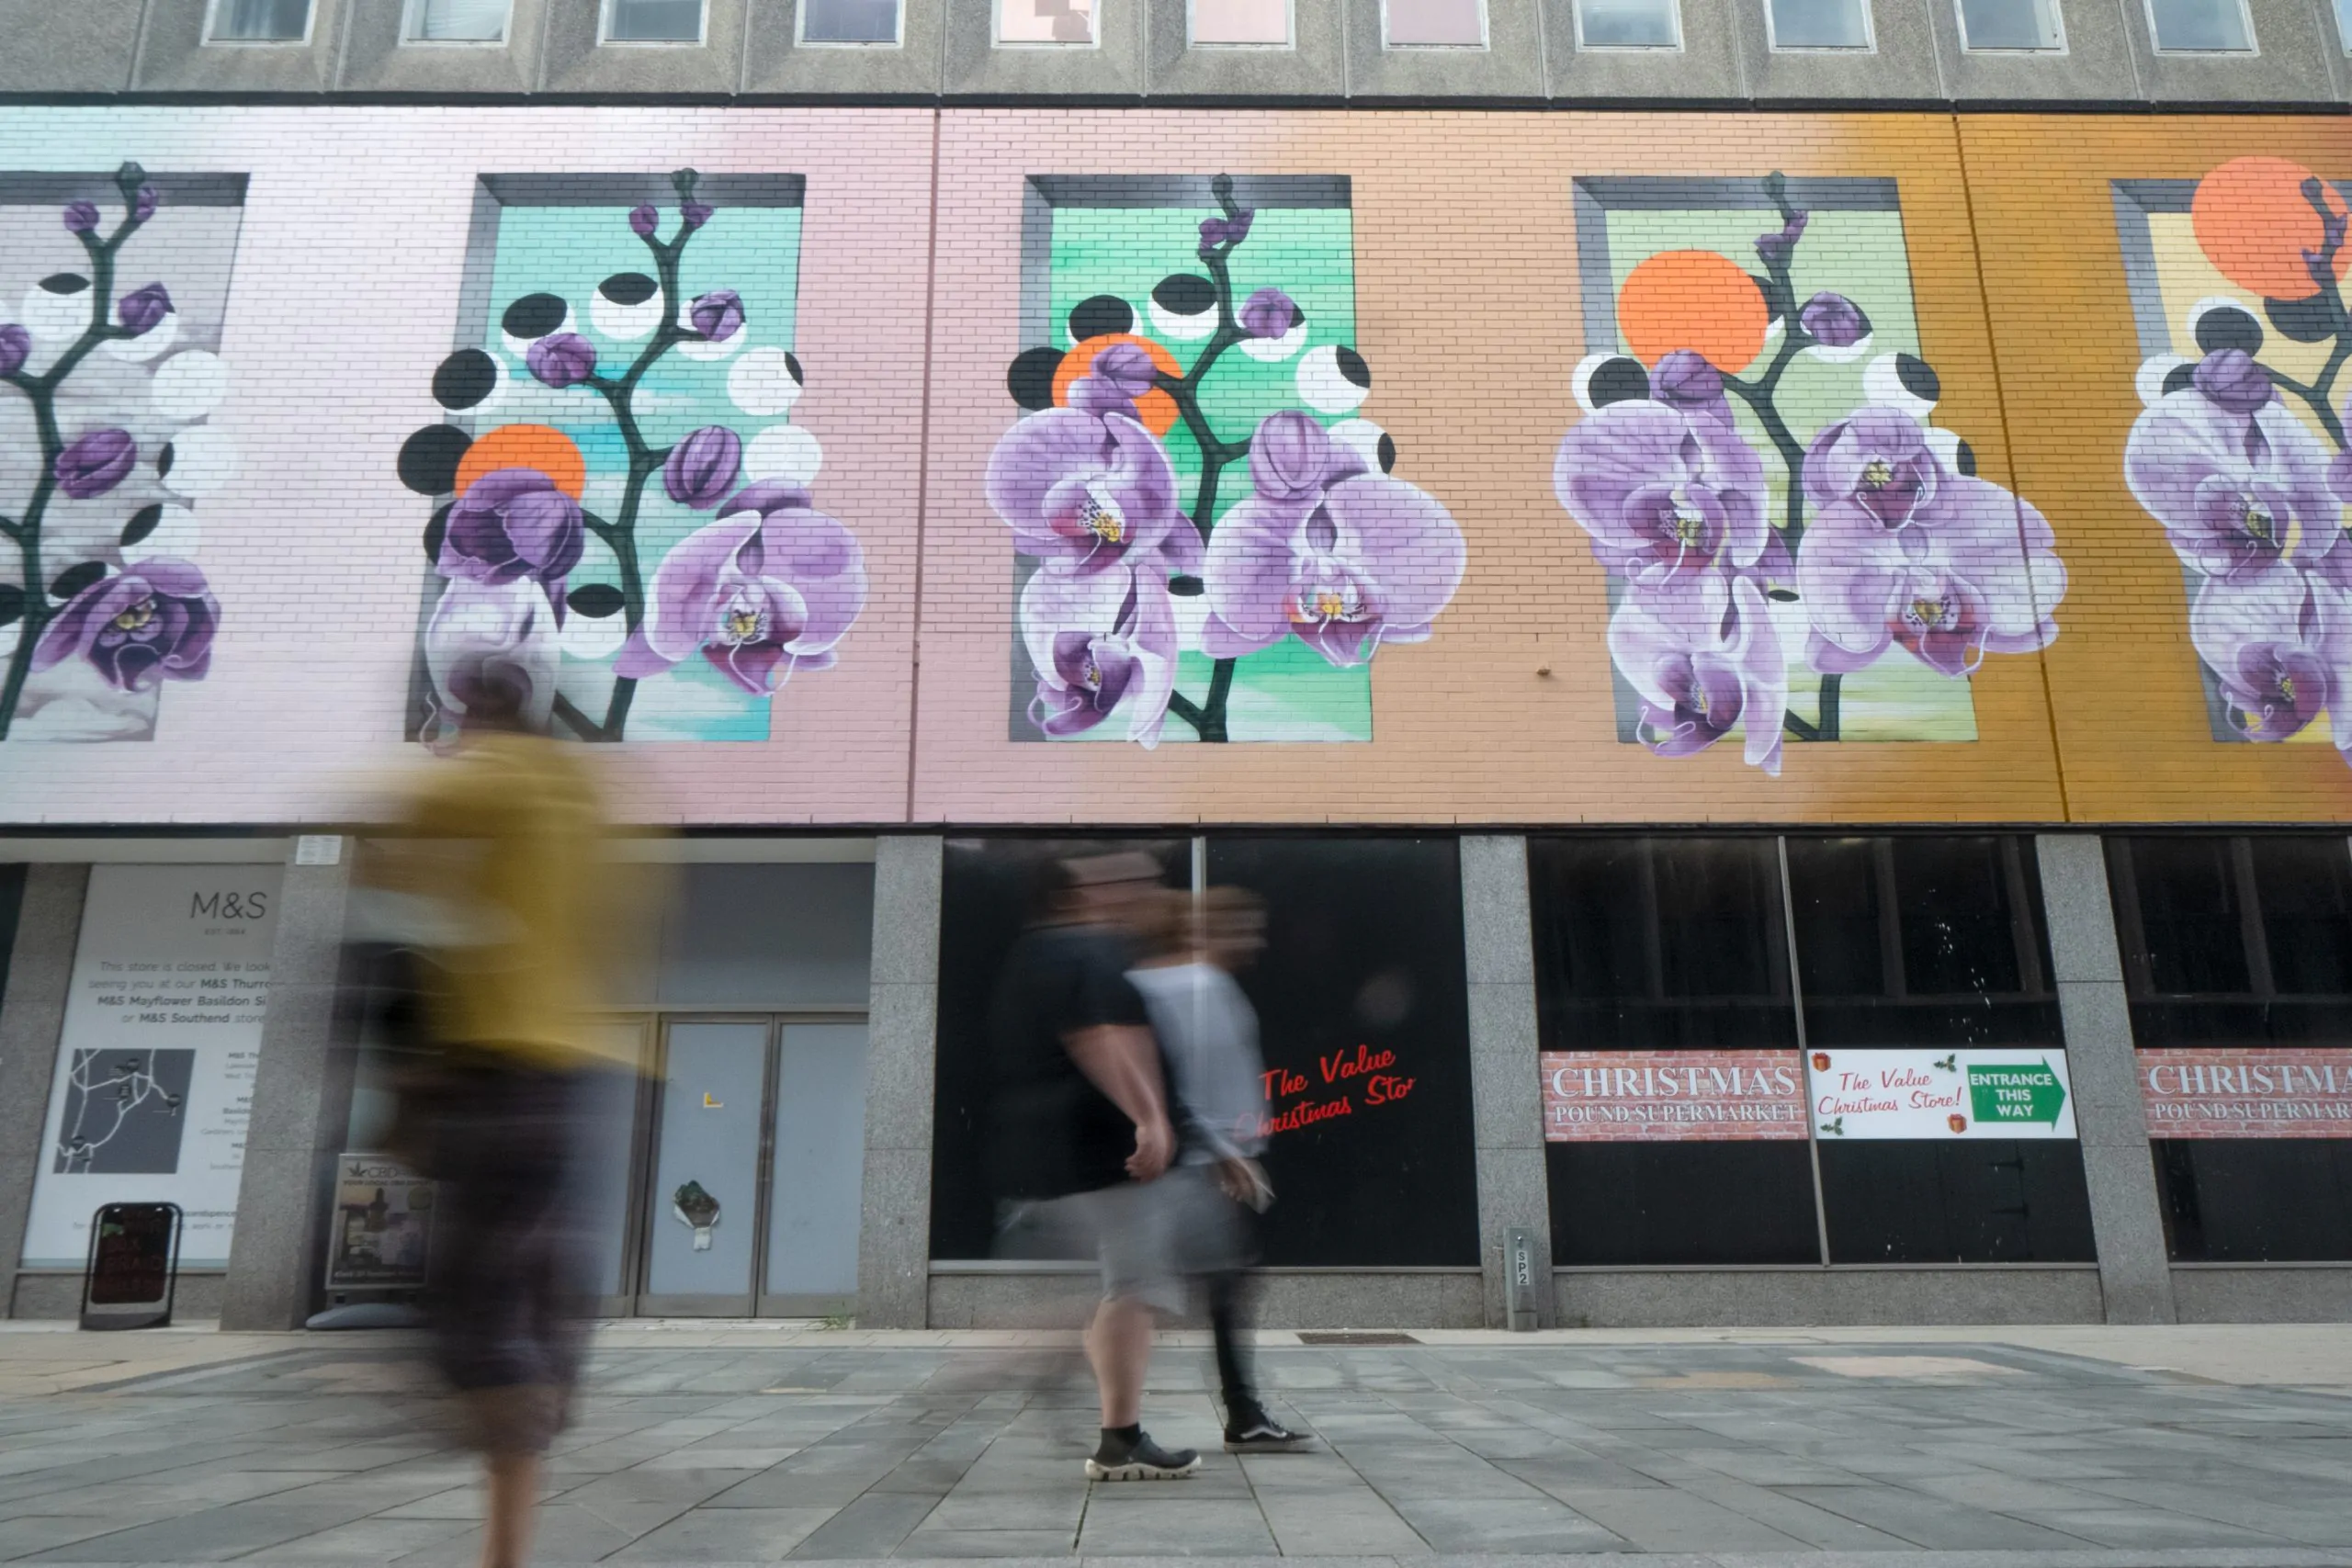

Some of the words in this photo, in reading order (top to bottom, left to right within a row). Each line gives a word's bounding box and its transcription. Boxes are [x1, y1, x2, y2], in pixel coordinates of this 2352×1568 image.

[189, 891, 267, 919] M&S
[100, 961, 122, 972] This
[128, 962, 158, 972] store
[162, 962, 172, 972] is
[222, 962, 241, 972] We
[244, 960, 270, 972] look
[88, 979, 127, 991] seeing
[131, 980, 154, 991] you
[159, 979, 172, 988] at
[175, 980, 197, 988] our
[200, 978, 228, 988] M&S
[97, 996, 125, 1006] M&S
[129, 996, 193, 1008] Mayflower
[197, 995, 250, 1006] Basildon
[120, 1014, 135, 1023] or
[139, 1012, 167, 1023] M&S
[171, 1012, 230, 1023] Southend
[1259, 1069, 1308, 1100] The
[1319, 1043, 1396, 1084] Value
[1838, 1072, 1871, 1091] The
[1881, 1067, 1932, 1089] Value
[1970, 1074, 2052, 1087] ENTRANCE
[1552, 1066, 1796, 1098] CHRISTMAS
[1818, 1094, 1898, 1115] Christmas
[1908, 1086, 1962, 1110] Store!
[1996, 1089, 2031, 1101] THIS
[1233, 1096, 1352, 1143] Christmas
[1555, 1105, 1631, 1123] POUND
[1634, 1103, 1799, 1122] SUPERMARKET
[1996, 1105, 2034, 1117] WAY
[2154, 1102, 2227, 1120] POUND
[1518, 1251, 1528, 1284] SP2
